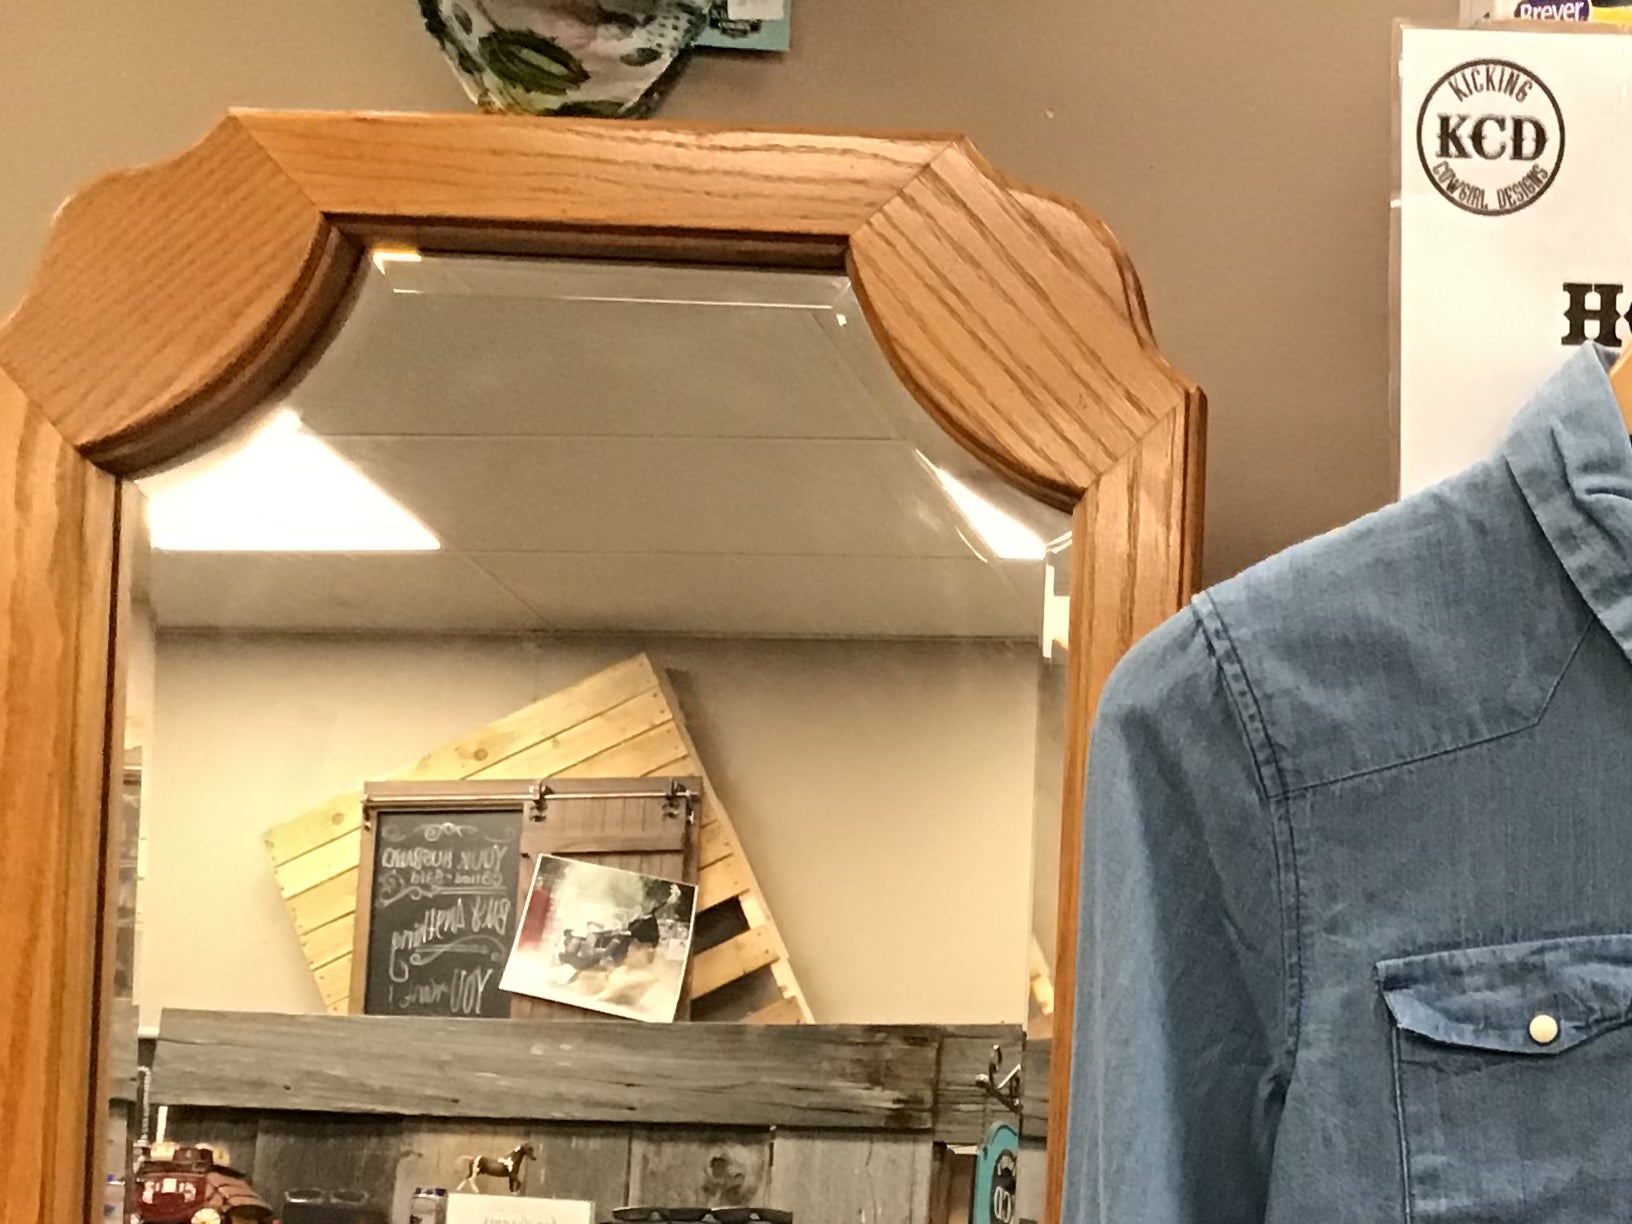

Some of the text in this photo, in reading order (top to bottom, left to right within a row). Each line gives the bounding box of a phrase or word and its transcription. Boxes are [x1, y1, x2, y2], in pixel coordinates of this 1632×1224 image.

[1448, 64, 1533, 102] KICKING
[1435, 112, 1550, 160] KCD
[1432, 160, 1549, 210] COWGIRL DESIGNS
